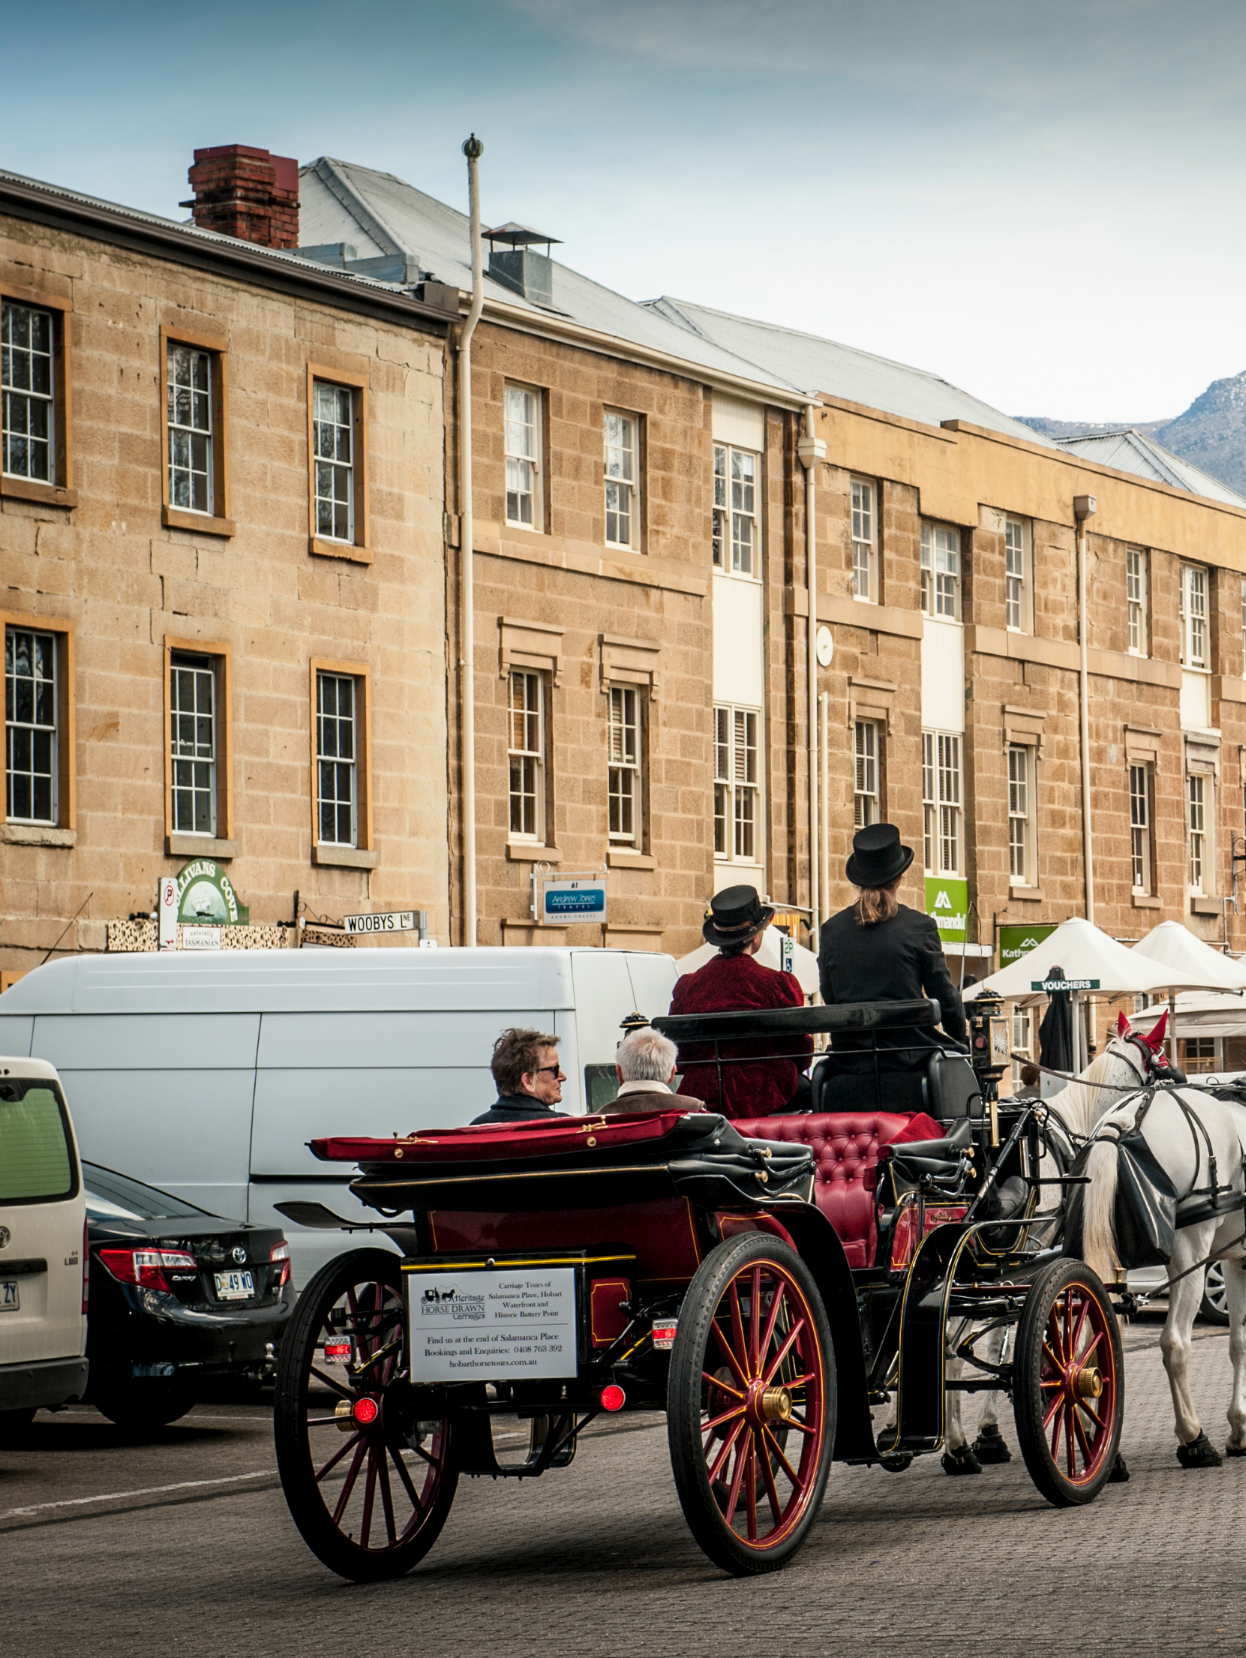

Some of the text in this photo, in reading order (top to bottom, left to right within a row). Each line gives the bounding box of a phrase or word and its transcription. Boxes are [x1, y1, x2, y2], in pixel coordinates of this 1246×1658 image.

[221, 876, 239, 923] COVE
[552, 893, 578, 903] Andrew
[347, 915, 395, 932] WOOBYS
[185, 939, 219, 948] TASMANIAN
[784, 941, 794, 954] 2P
[1041, 980, 1092, 991] VOUCHERS
[544, 1280, 552, 1288] of
[454, 1294, 485, 1303] Heritage
[521, 1291, 540, 1299] Place,
[540, 1290, 563, 1298] Hobart
[421, 1304, 485, 1314] HORSE DRAWN
[519, 1310, 541, 1318] Battery
[427, 1336, 444, 1344] Find
[462, 1335, 474, 1343] the
[475, 1334, 490, 1342] end
[491, 1334, 500, 1342] of
[500, 1333, 538, 1341] Salamanca
[540, 1332, 559, 1340] Place
[424, 1344, 563, 1357] Bookings and Enquiries: 0408 763 392
[449, 1359, 538, 1368] hobarthorsetours.com.au
